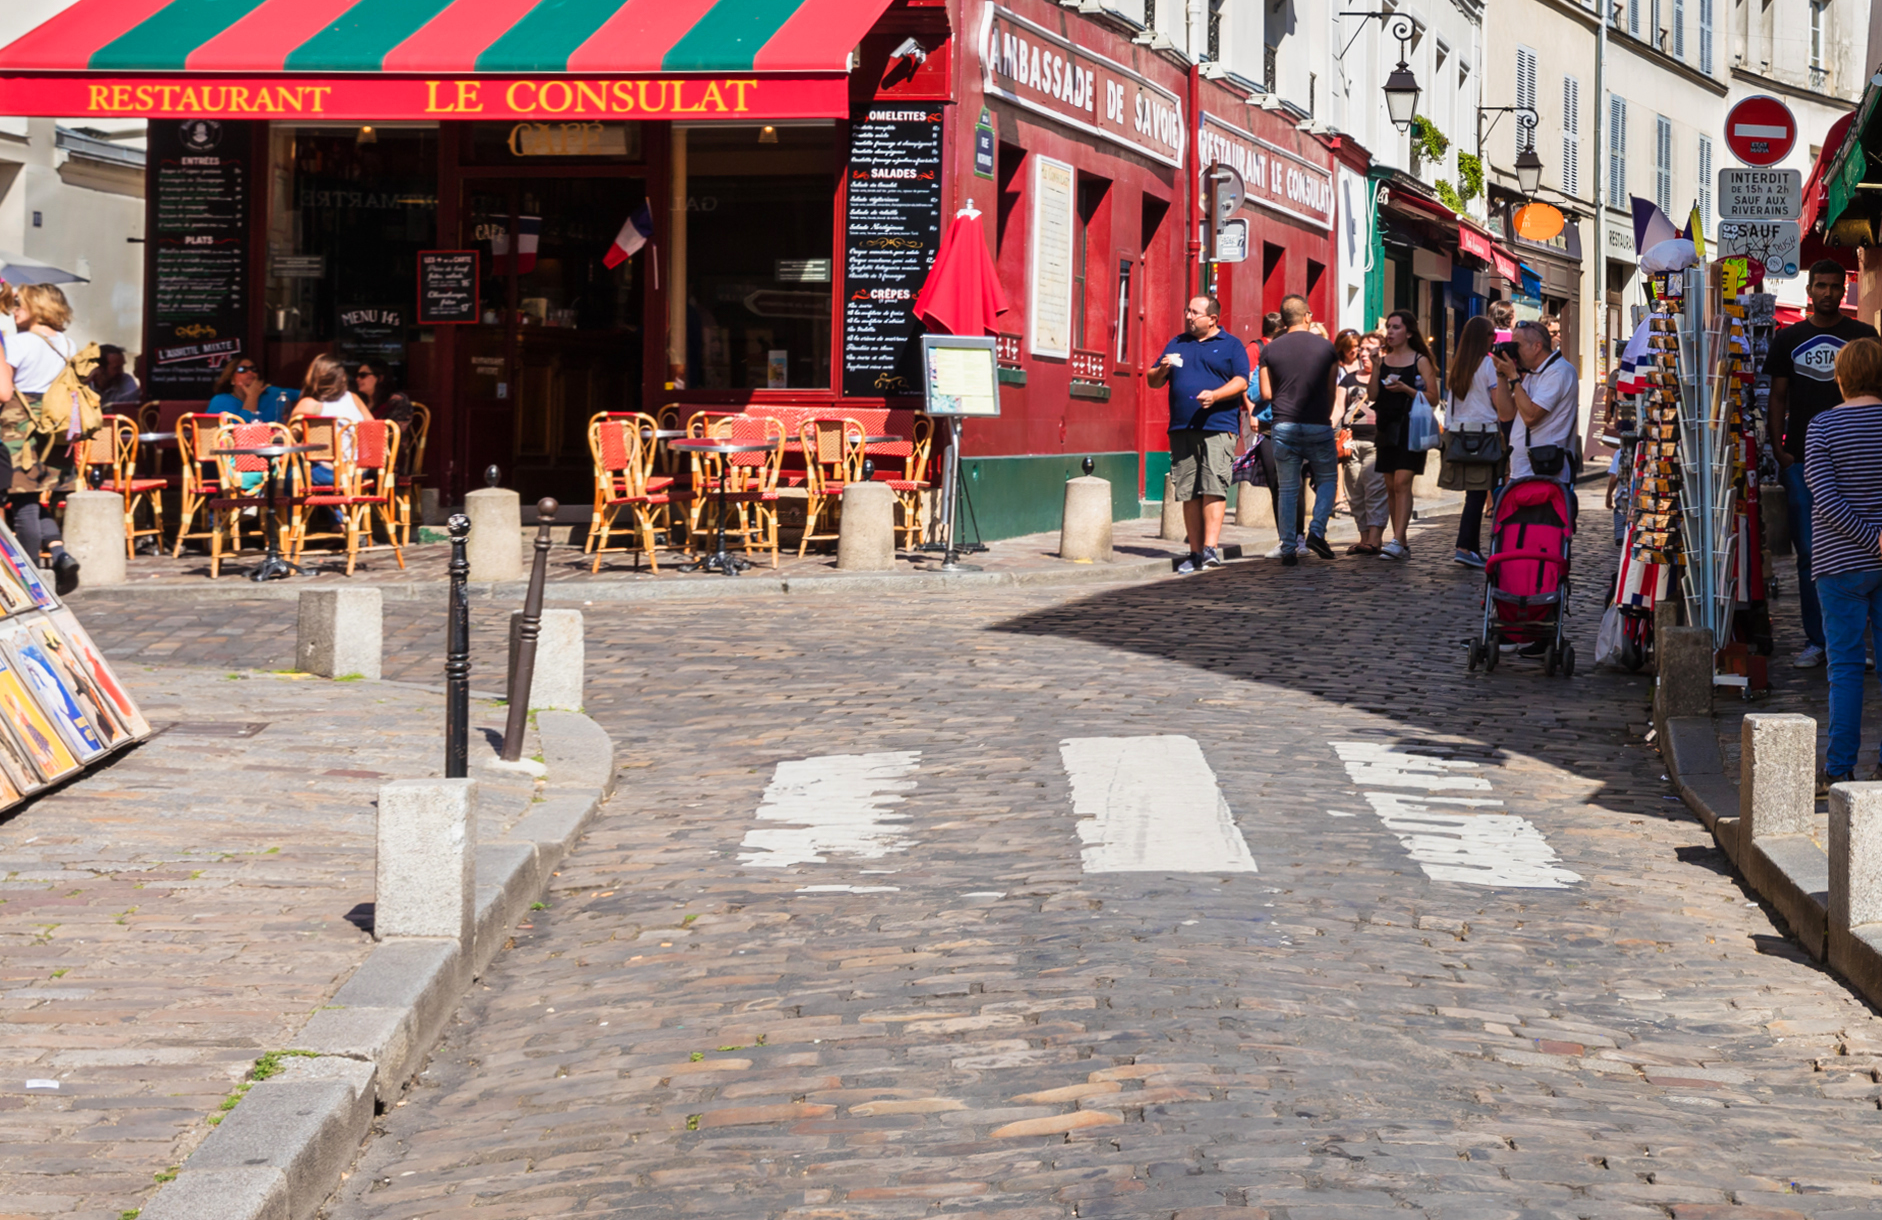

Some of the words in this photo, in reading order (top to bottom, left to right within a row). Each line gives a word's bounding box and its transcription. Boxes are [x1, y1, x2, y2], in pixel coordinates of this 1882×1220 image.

[989, 27, 1094, 113] AMBASSADE
[1106, 79, 1124, 125] DE
[1134, 92, 1179, 150] SAVOIE
[87, 85, 331, 113] RESTAURANT
[424, 80, 484, 113] LE
[505, 79, 757, 114] CONSULAT
[868, 111, 927, 121] OMELETTES
[870, 168, 917, 179] SALADES
[1731, 173, 1789, 184] INTERDIT
[1271, 160, 1282, 195] LE
[1286, 167, 1330, 215] CONSULAT
[1731, 185, 1742, 193] DE
[1745, 185, 1763, 194] 15h
[1767, 186, 1773, 194] A
[1776, 185, 1789, 194] 2h
[1734, 196, 1760, 205] SAUF
[1765, 196, 1786, 205] AUX
[1731, 206, 1789, 215] RIVERAINS
[1739, 224, 1781, 238] SAUF
[184, 235, 214, 245] PLATS
[1609, 230, 1635, 251] RESTAURAN
[870, 288, 911, 300] CRÊPES
[341, 309, 378, 327] MENU
[1805, 350, 1839, 365] G-STA
